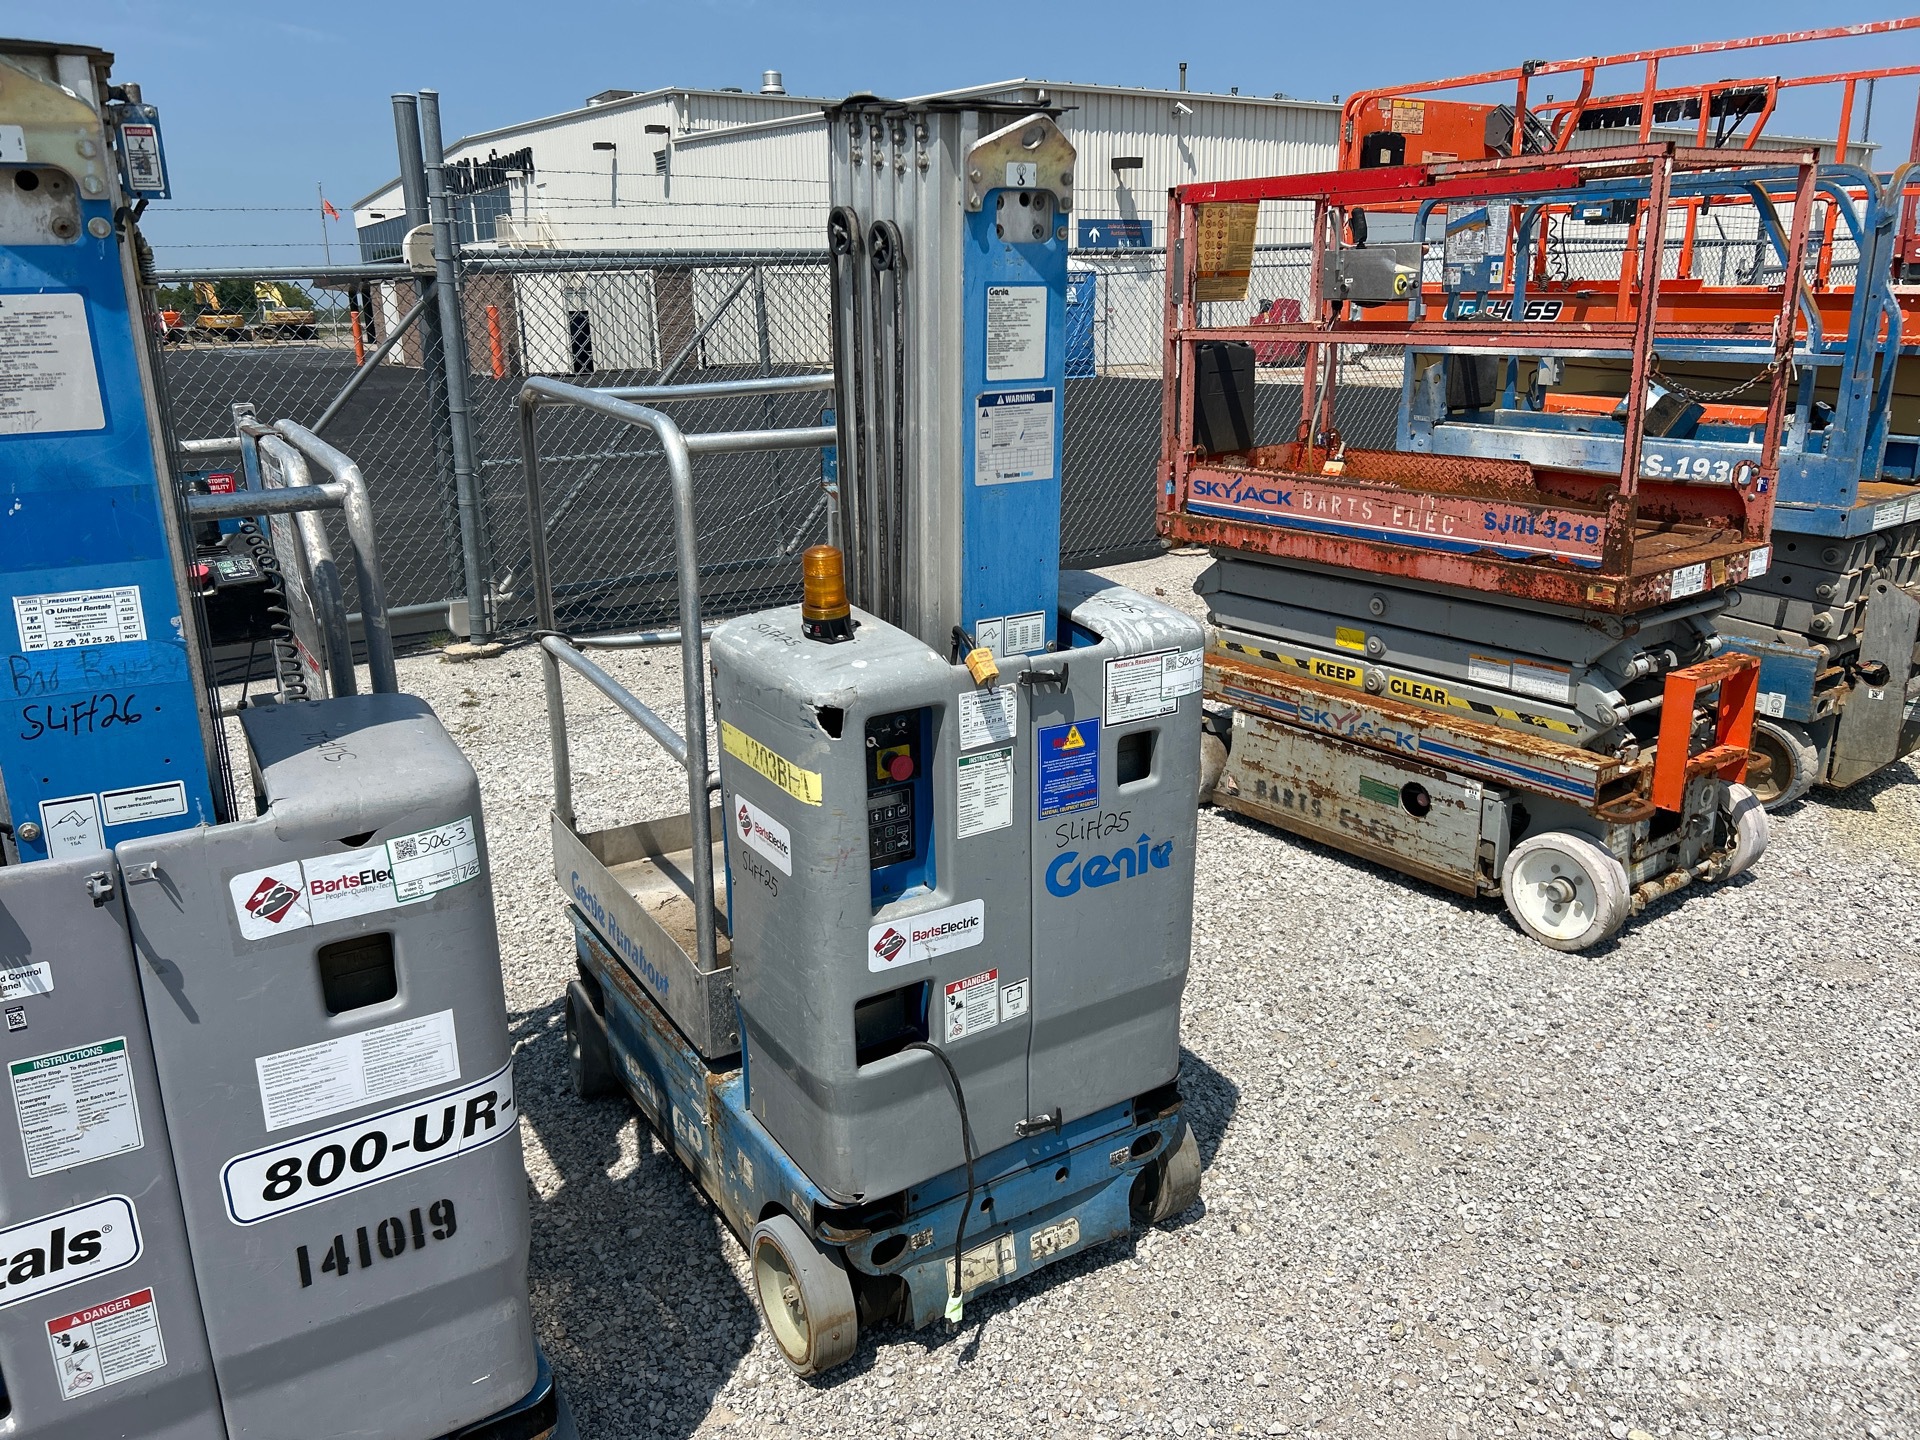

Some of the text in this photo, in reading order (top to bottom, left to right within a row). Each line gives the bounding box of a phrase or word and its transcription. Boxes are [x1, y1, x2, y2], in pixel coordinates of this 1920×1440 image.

[473, 147, 535, 192] Auctioneers
[989, 288, 1009, 296] Genie
[1006, 394, 1036, 404] WARNING
[1193, 476, 1293, 507] SKYJACK
[1302, 491, 1454, 535] BARTS ELEC
[1542, 520, 1600, 545] 3219
[56, 604, 112, 614] United Rentals
[1114, 660, 1134, 669] Renter's
[1314, 660, 1446, 706] KEEP CLEAR
[1300, 706, 1416, 751] SKYJACK
[969, 752, 1002, 764] INSTRUCTIONS
[1254, 778, 1322, 818] BARTS
[754, 822, 788, 855] BartsElectric
[1045, 832, 1174, 898] Genie
[429, 876, 451, 886] Inspection
[326, 890, 348, 900] People
[352, 885, 375, 896] Quality
[571, 870, 606, 928] Genie
[608, 910, 670, 996] Runabout
[912, 916, 979, 942] BartsElectric
[8, 968, 42, 981] Control
[962, 973, 990, 988] DANGER
[32, 1045, 103, 1069] INSTRUCTIONS
[77, 1059, 100, 1069] Position
[101, 1053, 124, 1063] Platform
[15, 1068, 61, 1084] Emergency Stop
[19, 1093, 50, 1105] Emergency
[20, 1100, 46, 1110] Lowering
[75, 1096, 89, 1104] After
[25, 1124, 52, 1135] Operation
[262, 1074, 516, 1201] 800-UR-
[296, 1198, 458, 1288] 141019
[83, 1298, 131, 1321] DANGER
